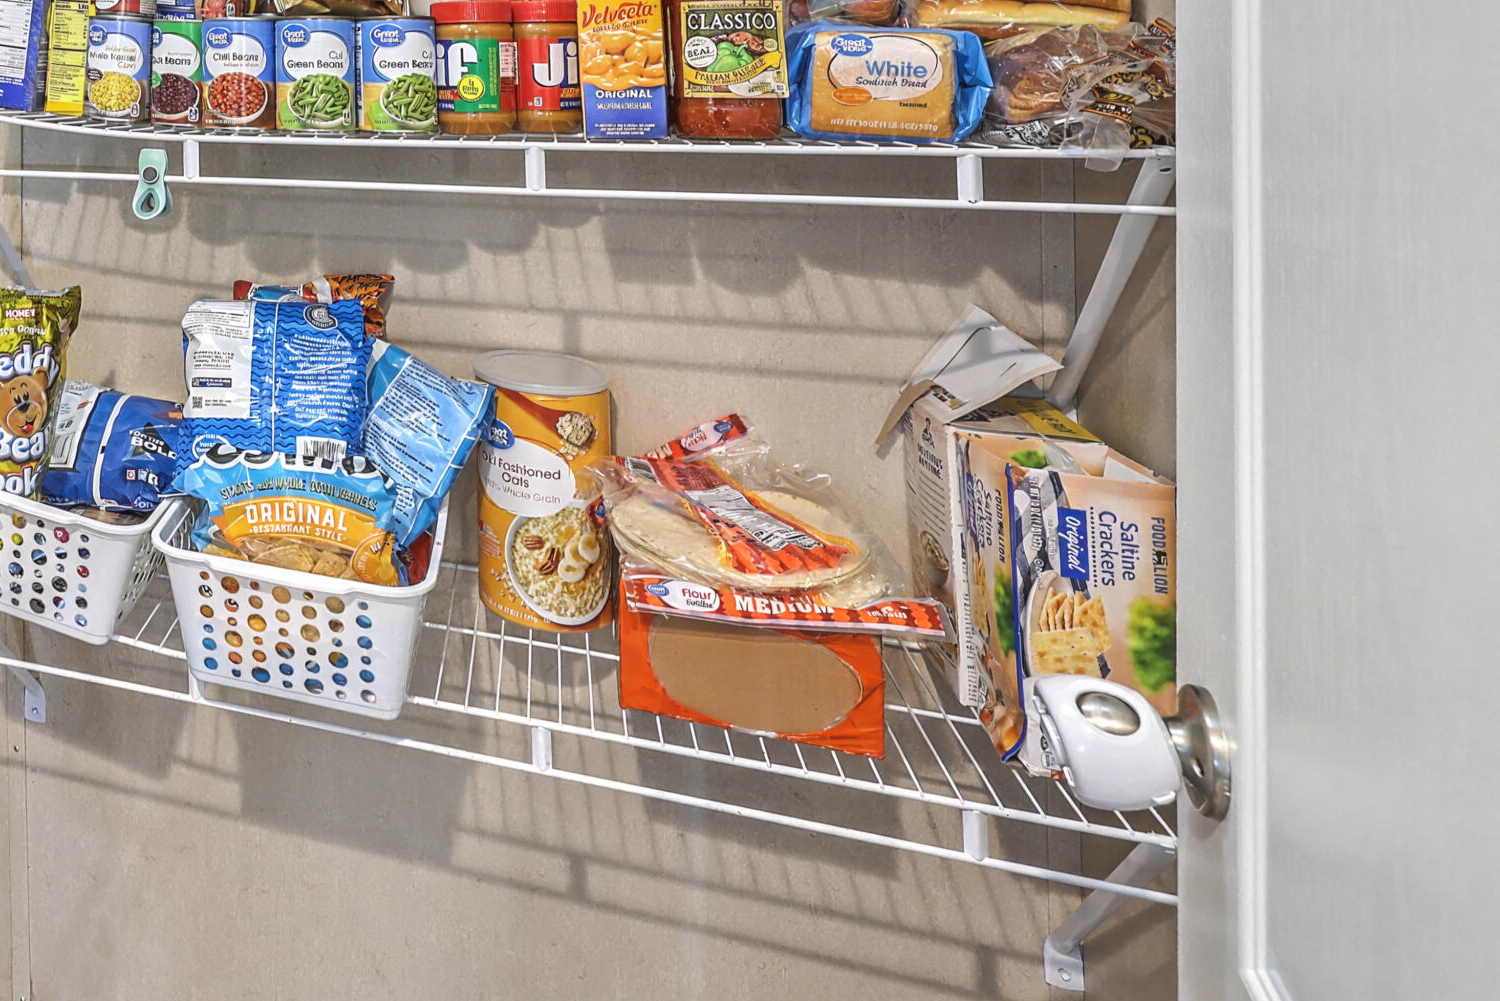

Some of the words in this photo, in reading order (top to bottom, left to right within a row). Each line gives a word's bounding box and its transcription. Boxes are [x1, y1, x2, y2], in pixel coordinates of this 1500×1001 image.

[582, 1, 653, 29] Velveeta
[687, 12, 776, 30] CLASSICO
[213, 52, 230, 61] Chili
[233, 52, 259, 62] Beans
[287, 59, 315, 70] Green
[317, 60, 344, 69] Beans
[379, 60, 409, 69] Green
[532, 41, 579, 88] Ji
[865, 60, 927, 78] White
[855, 76, 898, 87] Sandwich
[595, 89, 653, 99] ORIGINAL
[5, 309, 36, 318] HONEY
[131, 436, 178, 460] BOLD
[498, 457, 562, 480] Fashioned
[501, 471, 529, 489] Oats
[245, 502, 348, 531] ORIGINAL
[315, 527, 344, 541] STYLE
[1151, 516, 1167, 549] FOOD
[1058, 515, 1086, 574] Original
[1098, 511, 1119, 587] Crackers
[1119, 521, 1140, 582] Saltine
[1153, 566, 1169, 594] LION
[681, 587, 712, 602] Flour
[733, 592, 835, 615] MEDIUM
